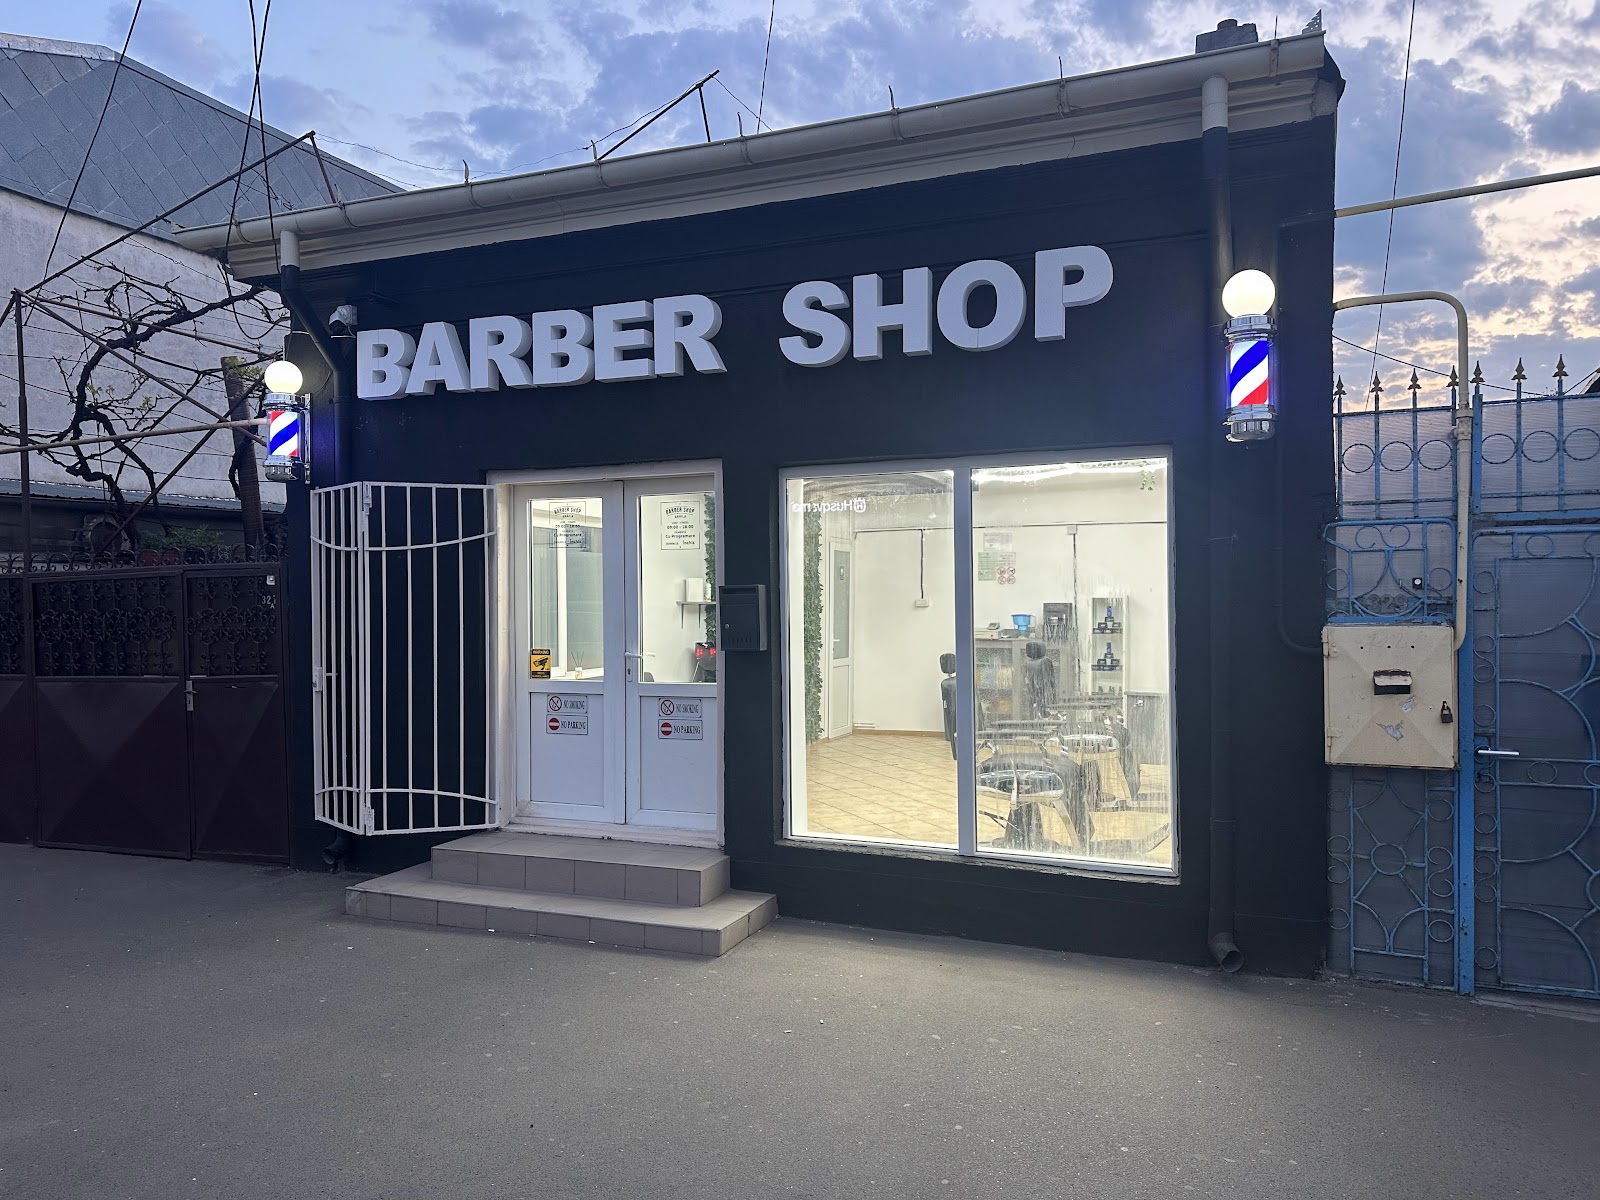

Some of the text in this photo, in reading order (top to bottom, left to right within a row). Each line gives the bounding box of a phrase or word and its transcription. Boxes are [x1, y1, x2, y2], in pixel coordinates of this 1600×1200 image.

[357, 245, 1113, 399] BARBER SHOP
[560, 721, 586, 729] NO PARKING
[673, 725, 700, 734] NO PARKING
